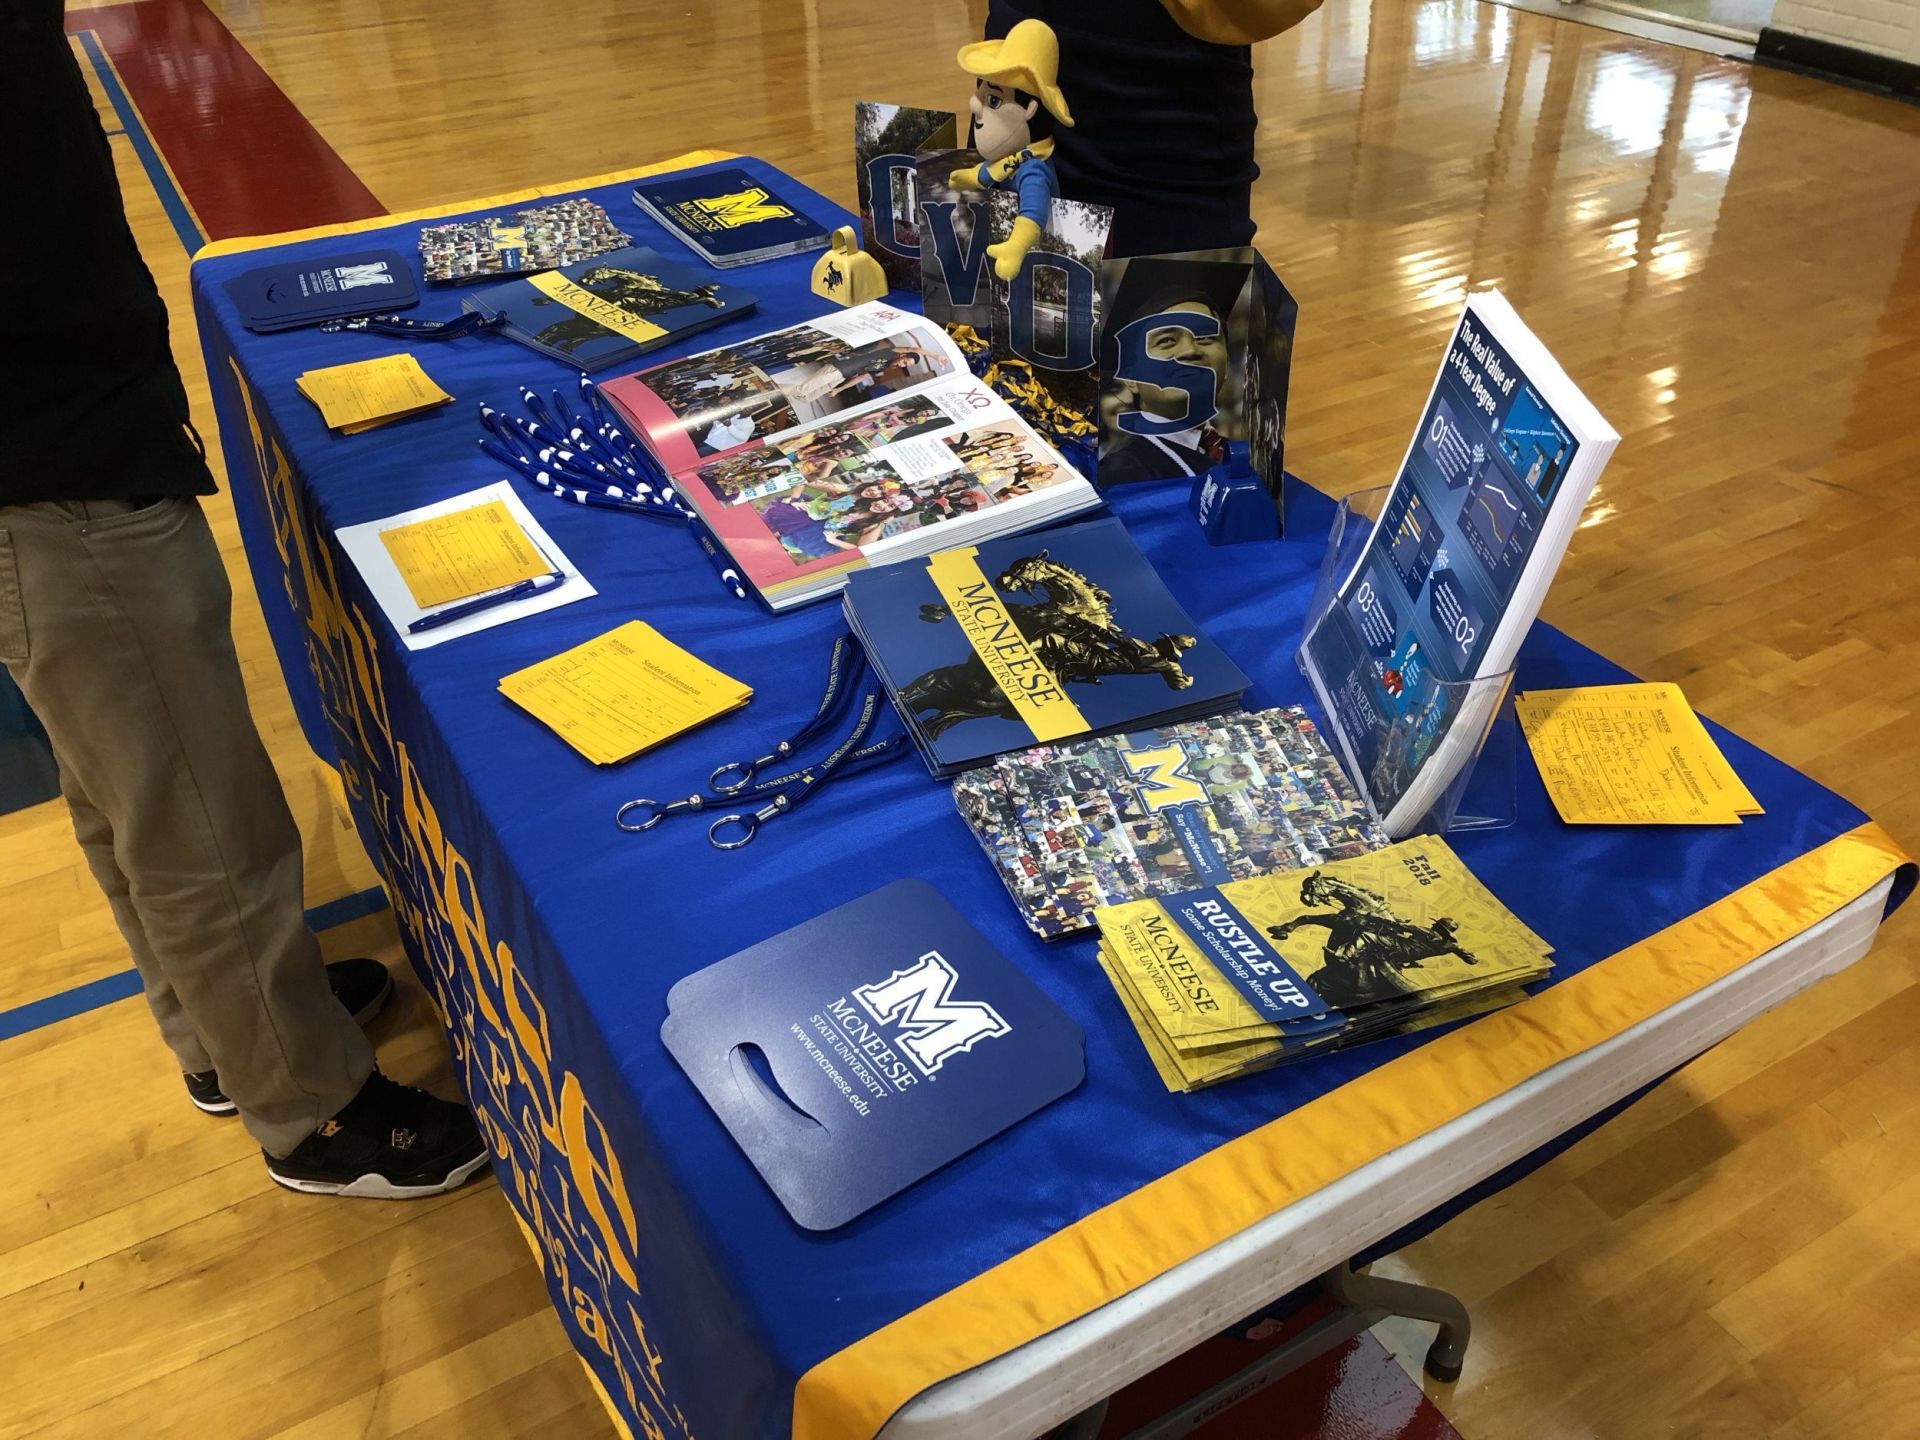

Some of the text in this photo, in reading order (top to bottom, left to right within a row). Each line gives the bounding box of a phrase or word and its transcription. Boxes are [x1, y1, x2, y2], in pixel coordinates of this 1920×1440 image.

[693, 188, 795, 229] M
[335, 261, 394, 291] M
[553, 282, 646, 330] MCNEESE
[1113, 310, 1221, 436] S
[1449, 348, 1497, 416] a 4-Year Degree
[1459, 319, 1517, 397] The Real Value of
[1431, 415, 1449, 448] 01
[1357, 582, 1375, 613] 03
[1455, 616, 1475, 655] 02
[641, 658, 669, 680] Student
[665, 670, 702, 697] Information
[951, 599, 1029, 703] STATE UNIVERSITY
[956, 581, 1065, 708] MCNEESE
[1117, 739, 1214, 817] M
[1670, 744, 1691, 775] Student
[1684, 768, 1709, 806] Information
[1175, 812, 1187, 828] Say
[1402, 858, 1431, 886] 2018
[1414, 854, 1441, 880] Fall
[1120, 923, 1185, 1014] STATE UNIVERSITY
[1141, 914, 1220, 1015] MCNEESE
[1181, 908, 1283, 1012] Some Scholarship Money!
[1192, 899, 1310, 1008] RUSTLE UP
[826, 996, 920, 1092] MCNEESE
[851, 950, 1013, 1077] M
[789, 1022, 871, 1117] www.mcneese.edu
[809, 1013, 888, 1100] STATE UNIVERSITY
